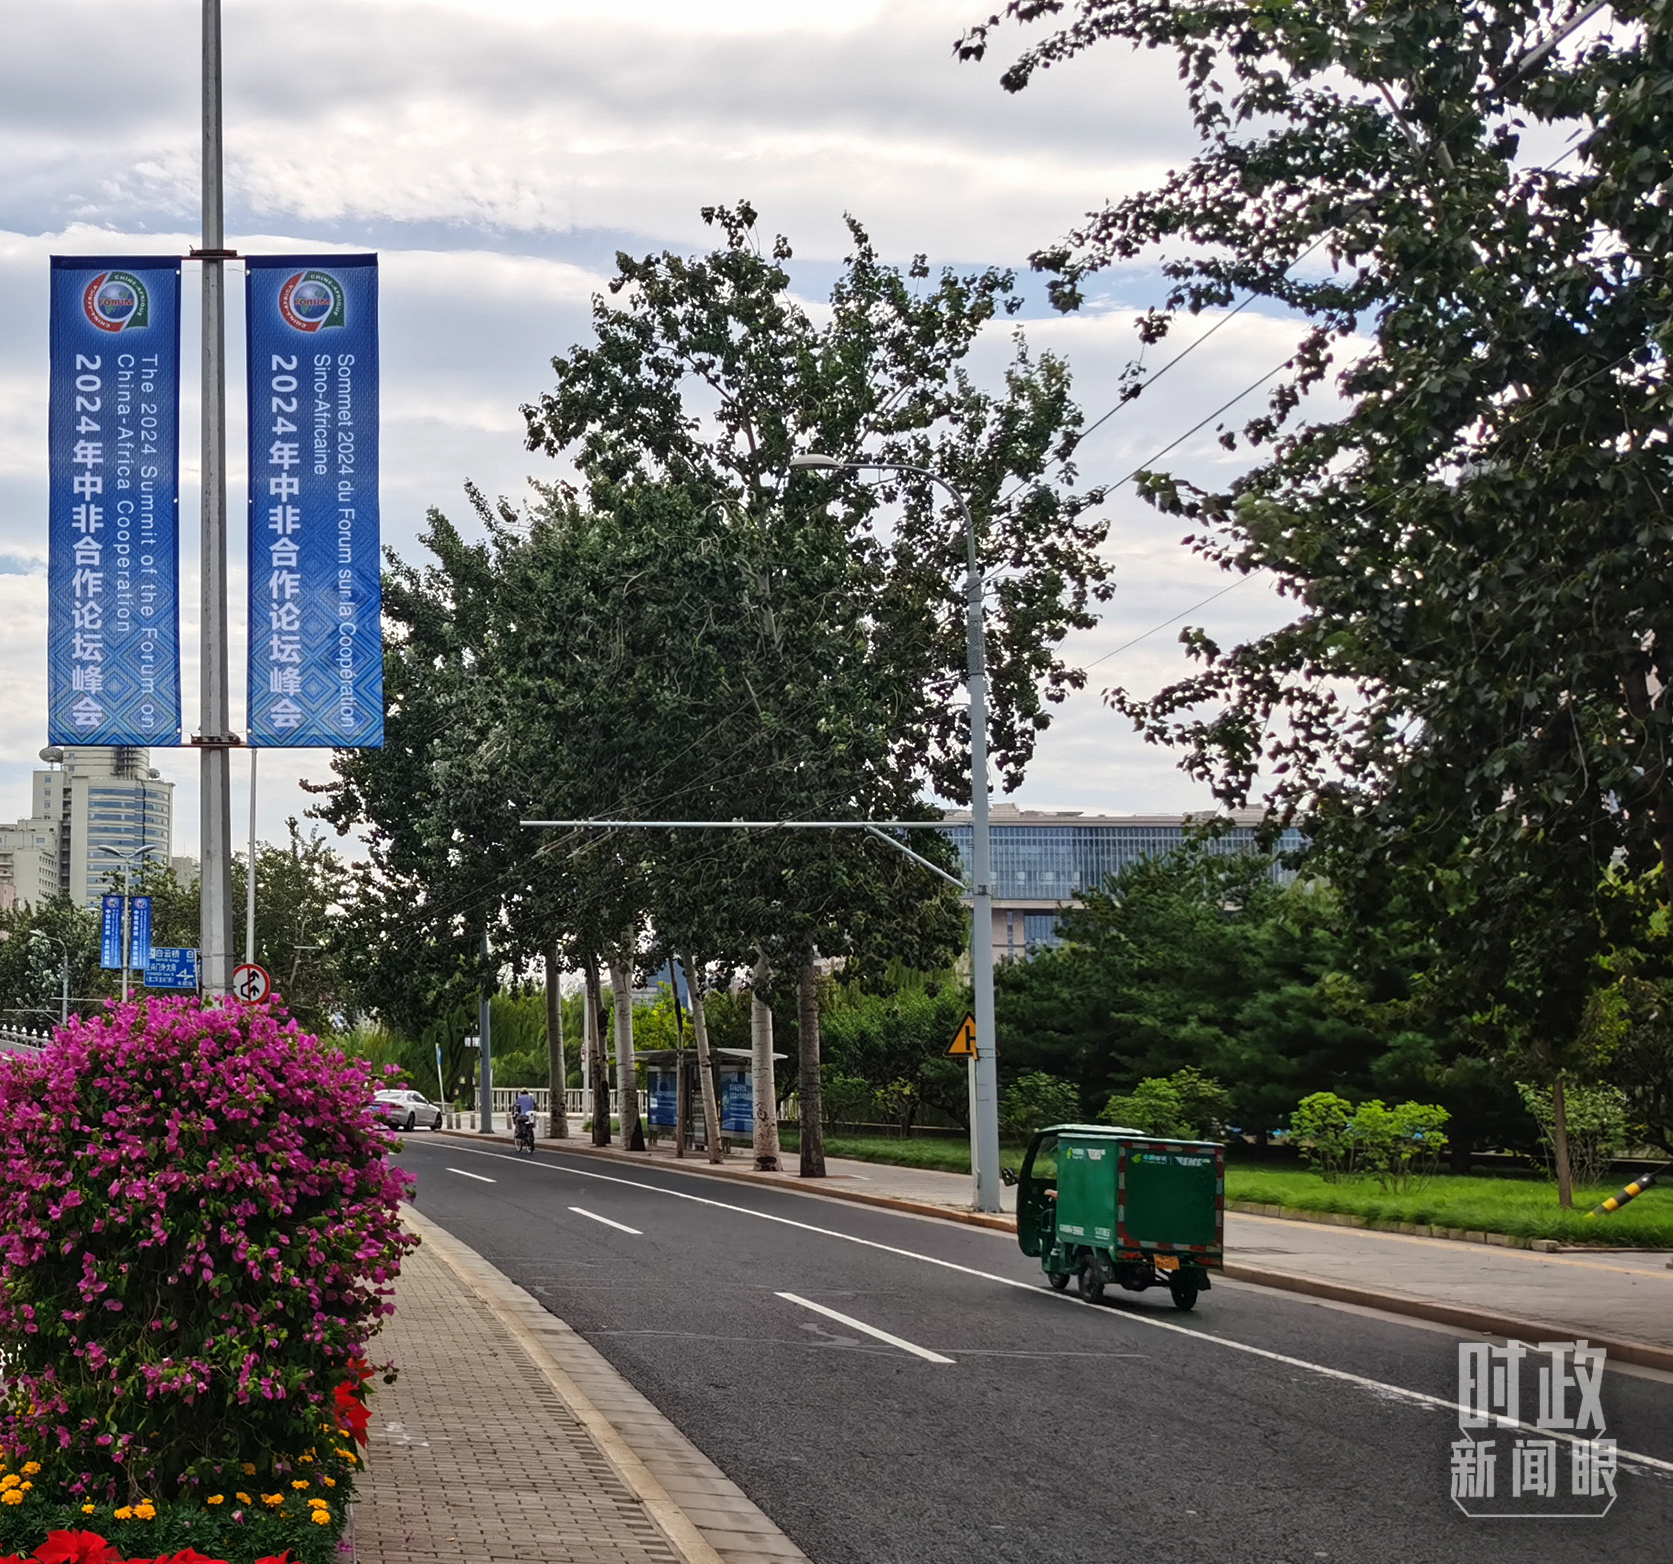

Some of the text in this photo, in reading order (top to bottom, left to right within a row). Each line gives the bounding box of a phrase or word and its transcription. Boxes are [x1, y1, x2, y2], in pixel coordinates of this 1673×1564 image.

[72, 354, 104, 729] 2024年中非合作论坛峰会
[114, 353, 135, 632] China-Africa Cooperation
[140, 353, 158, 728] The 2024 Summit of the Forum on
[268, 354, 302, 729] 2024年中非合作论坛峰会
[313, 353, 331, 475] Sino-Africaine
[336, 353, 357, 727] Sommet 2024 du Forum sur la Coopération
